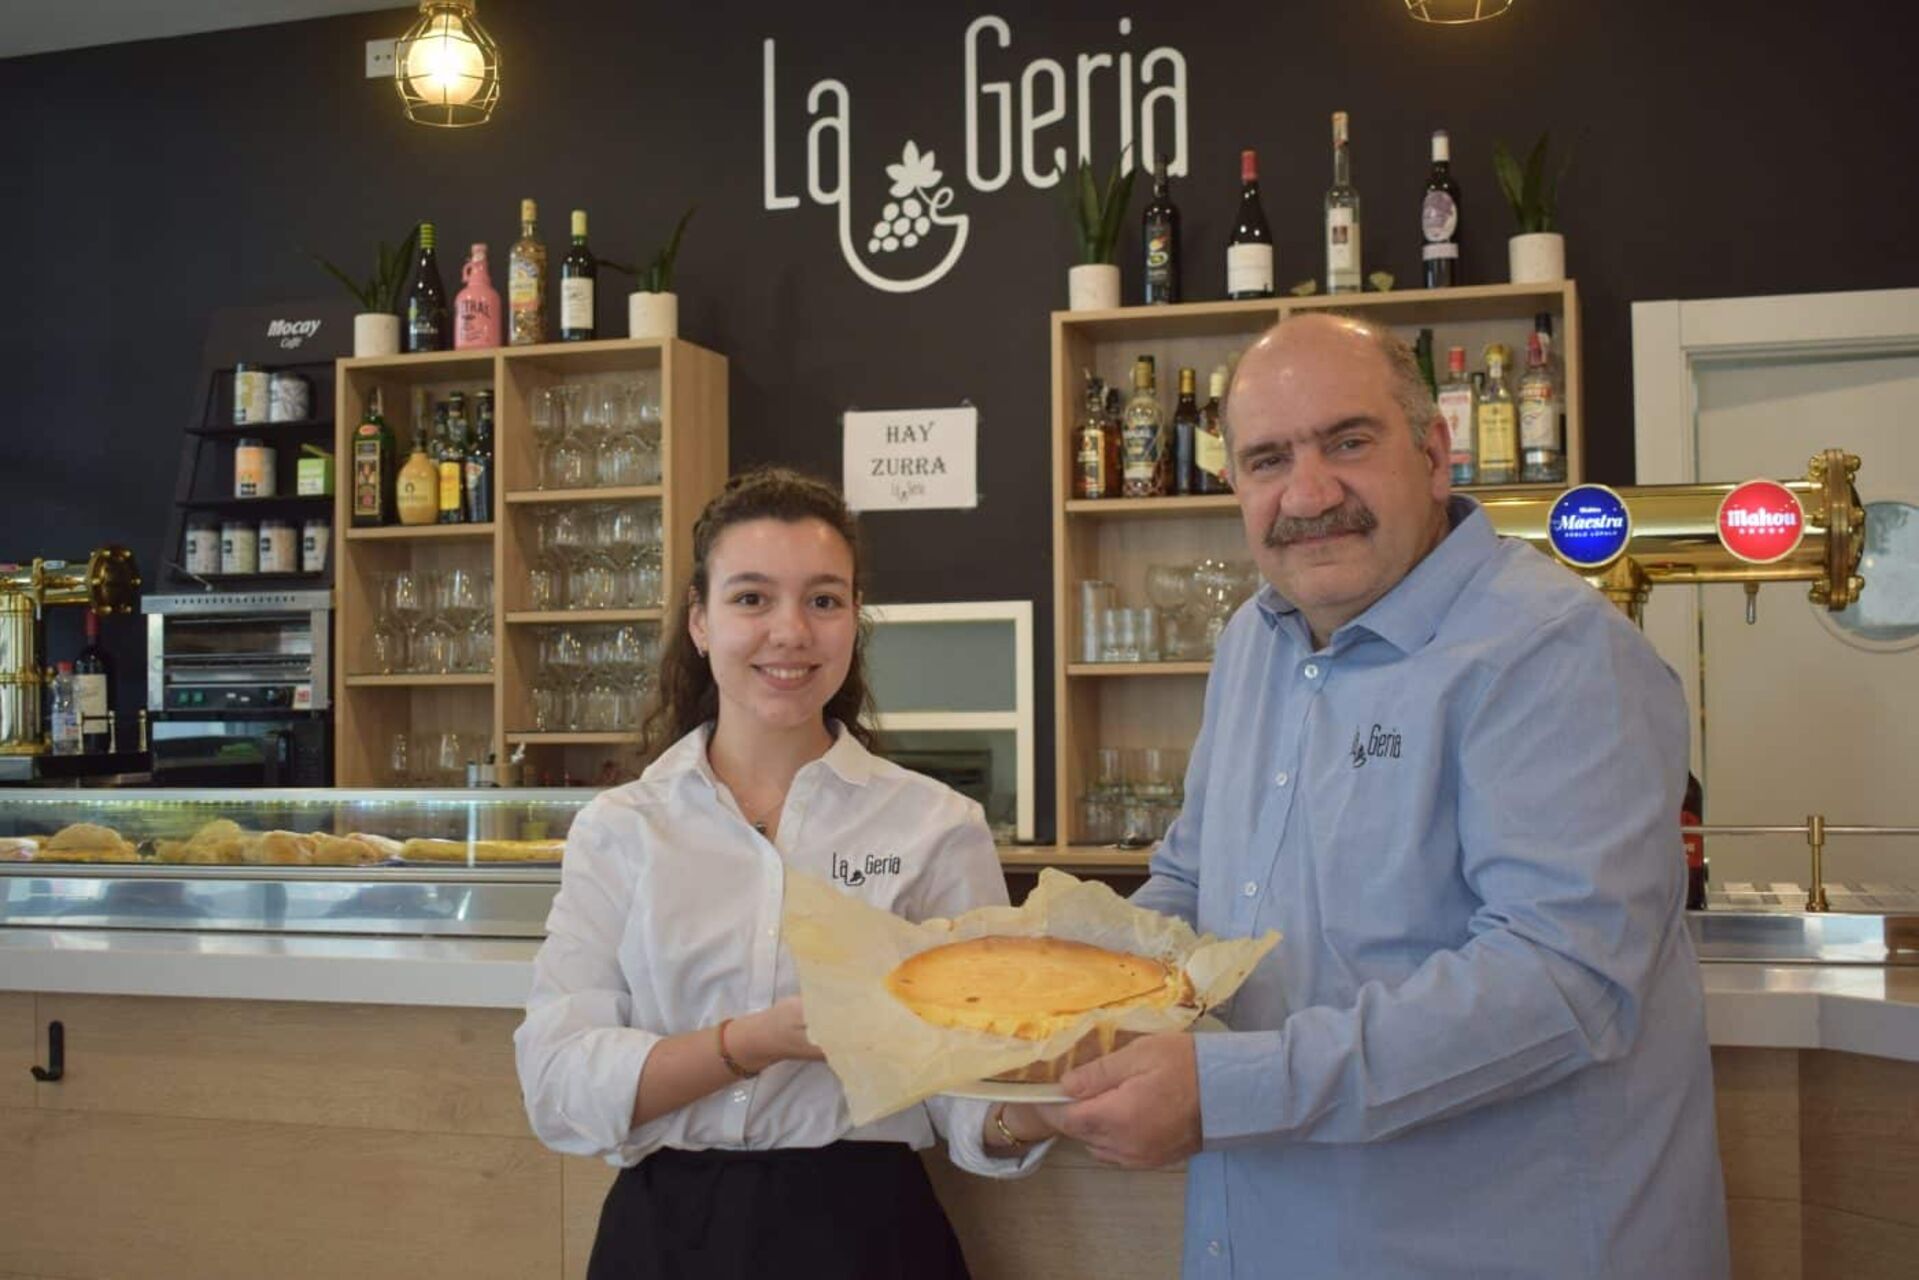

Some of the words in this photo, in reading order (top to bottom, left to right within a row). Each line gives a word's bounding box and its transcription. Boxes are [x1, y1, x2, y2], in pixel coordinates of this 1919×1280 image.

[965, 15, 1188, 192] Geria
[267, 319, 321, 338] Mocay
[886, 421, 935, 444] HAY
[871, 456, 947, 477] ZURRA
[1555, 514, 1624, 531] Maestra
[1727, 507, 1797, 527] Mahou
[1367, 723, 1402, 759] Geria
[865, 854, 902, 875] Geria
